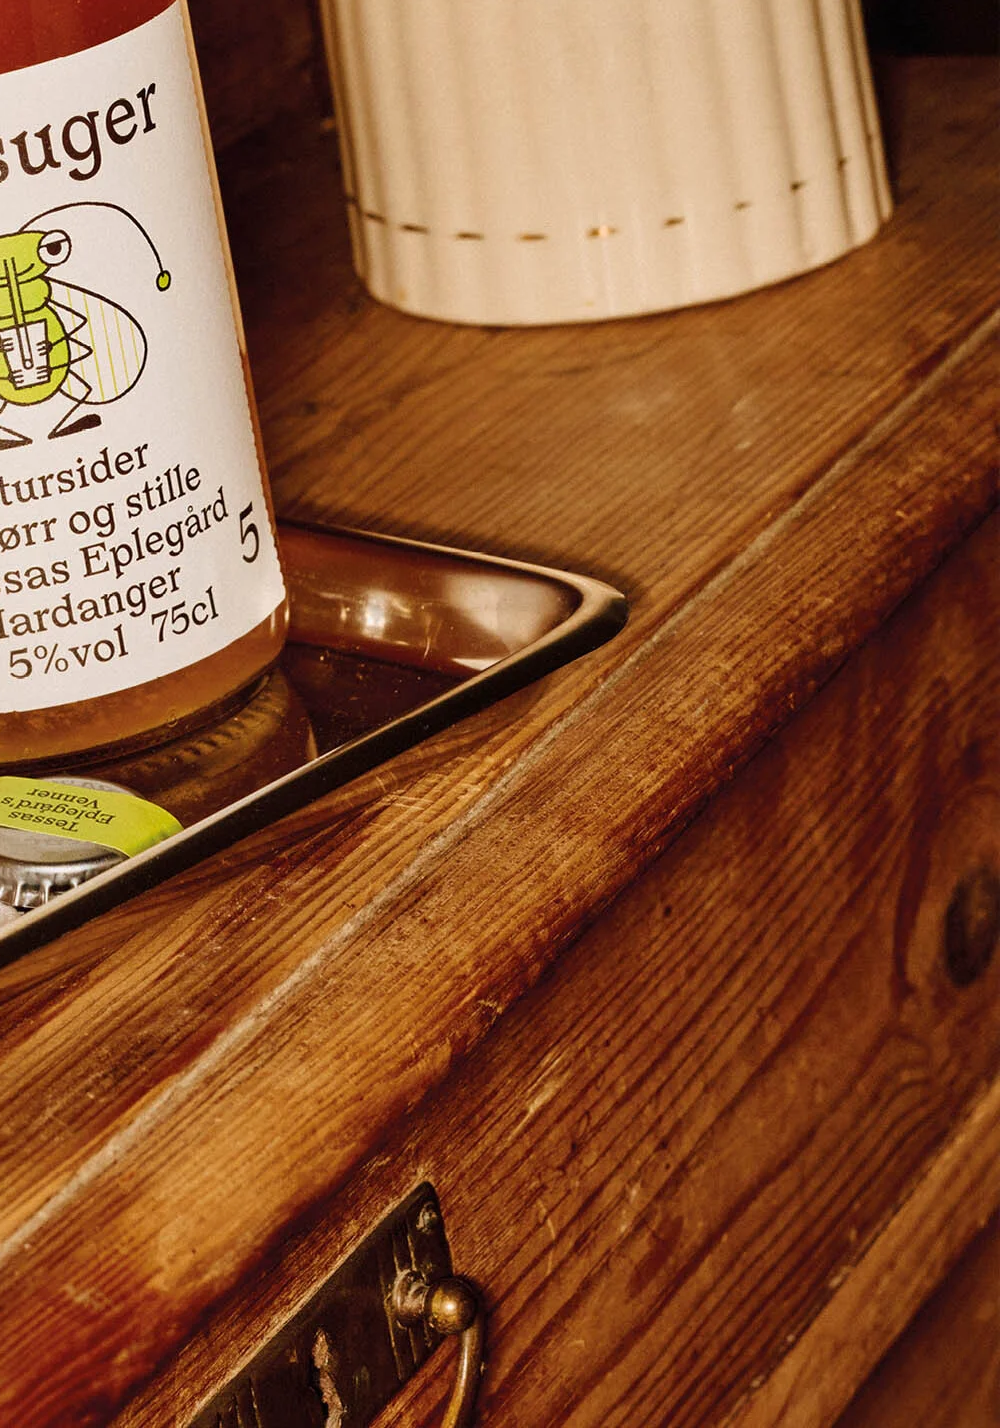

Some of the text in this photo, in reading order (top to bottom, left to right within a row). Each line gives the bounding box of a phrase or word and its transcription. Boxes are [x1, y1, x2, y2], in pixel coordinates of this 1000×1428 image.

[69, 502, 116, 538] og
[126, 464, 201, 519] stille
[80, 485, 229, 579] Eplegård
[239, 500, 261, 564] 5
[151, 586, 219, 643] 75cl
[8, 810, 79, 833] Tessas
[27, 787, 101, 810] Venner
